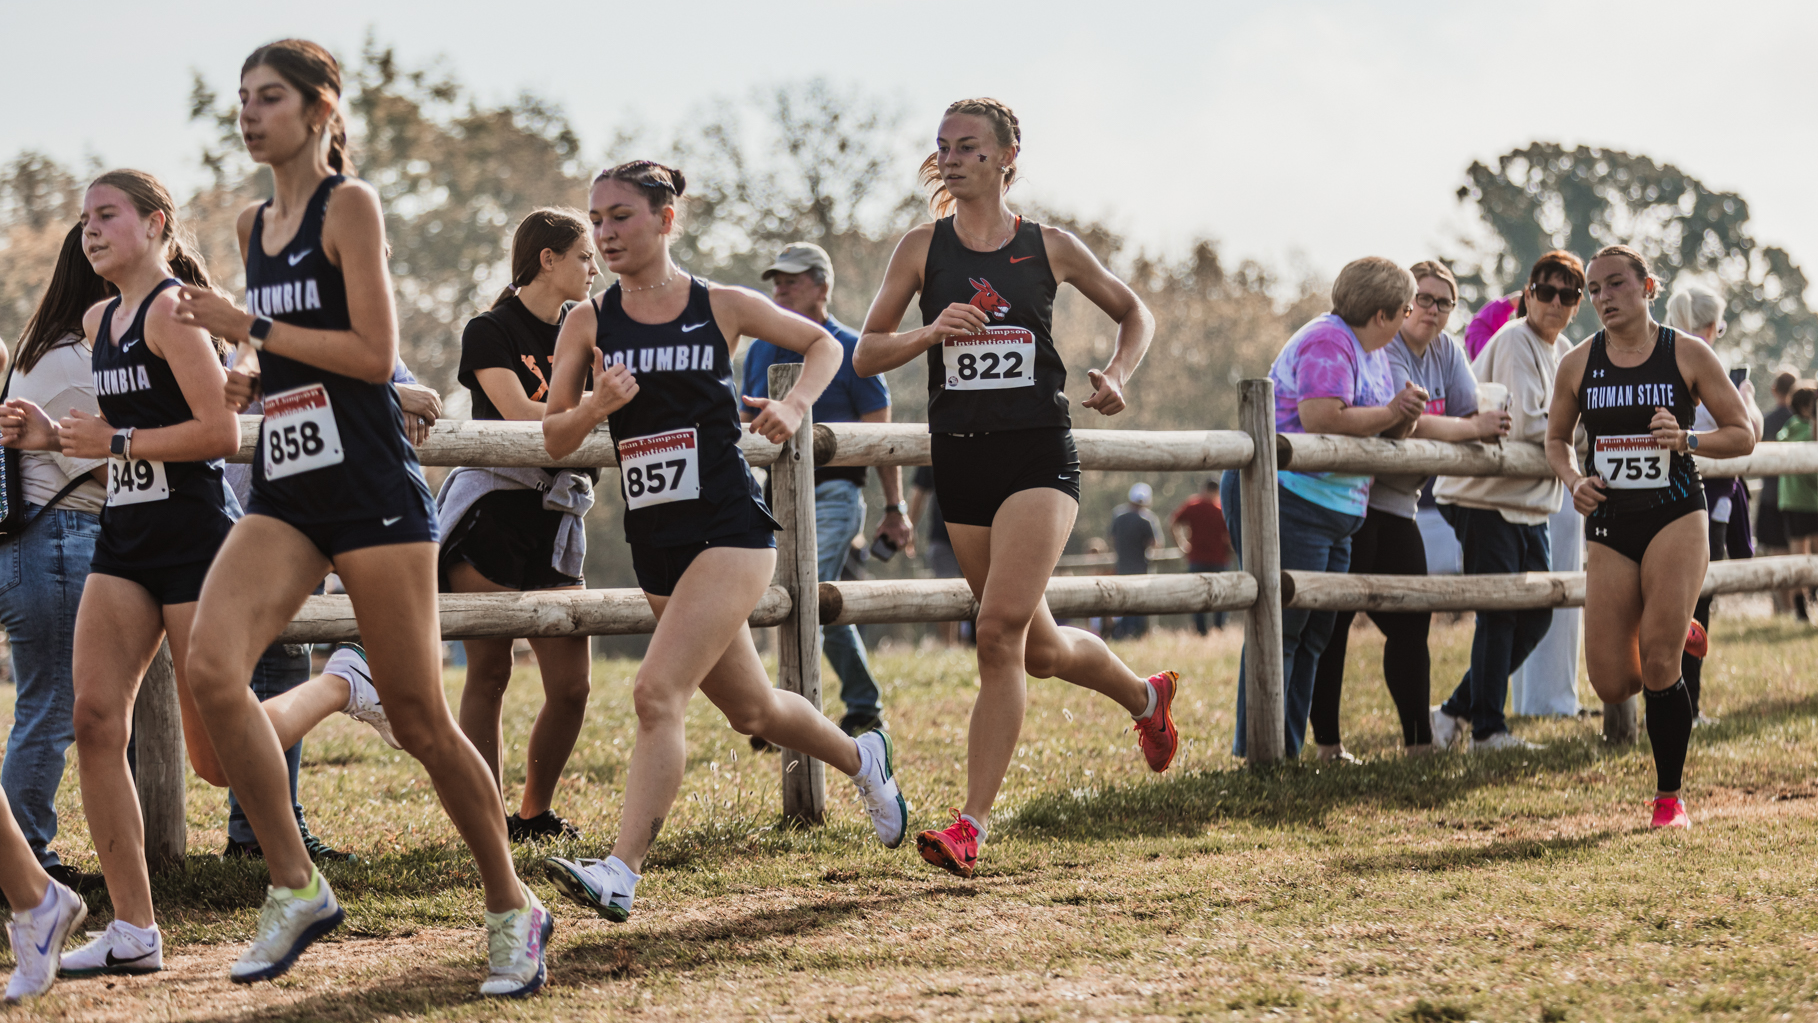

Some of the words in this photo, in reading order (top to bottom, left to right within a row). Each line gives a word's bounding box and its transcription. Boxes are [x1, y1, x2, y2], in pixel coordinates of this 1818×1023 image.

[953, 338, 1024, 347] Invitational
[603, 345, 714, 374] COLUMBIA
[957, 351, 1023, 381] 822
[1586, 385, 1633, 410] TRUMAN
[1638, 383, 1675, 407] STATE
[270, 421, 325, 465] 858
[621, 442, 687, 461] Invitational
[647, 432, 690, 444] Simpson
[627, 458, 687, 498] 857
[1607, 457, 1662, 481] 753
